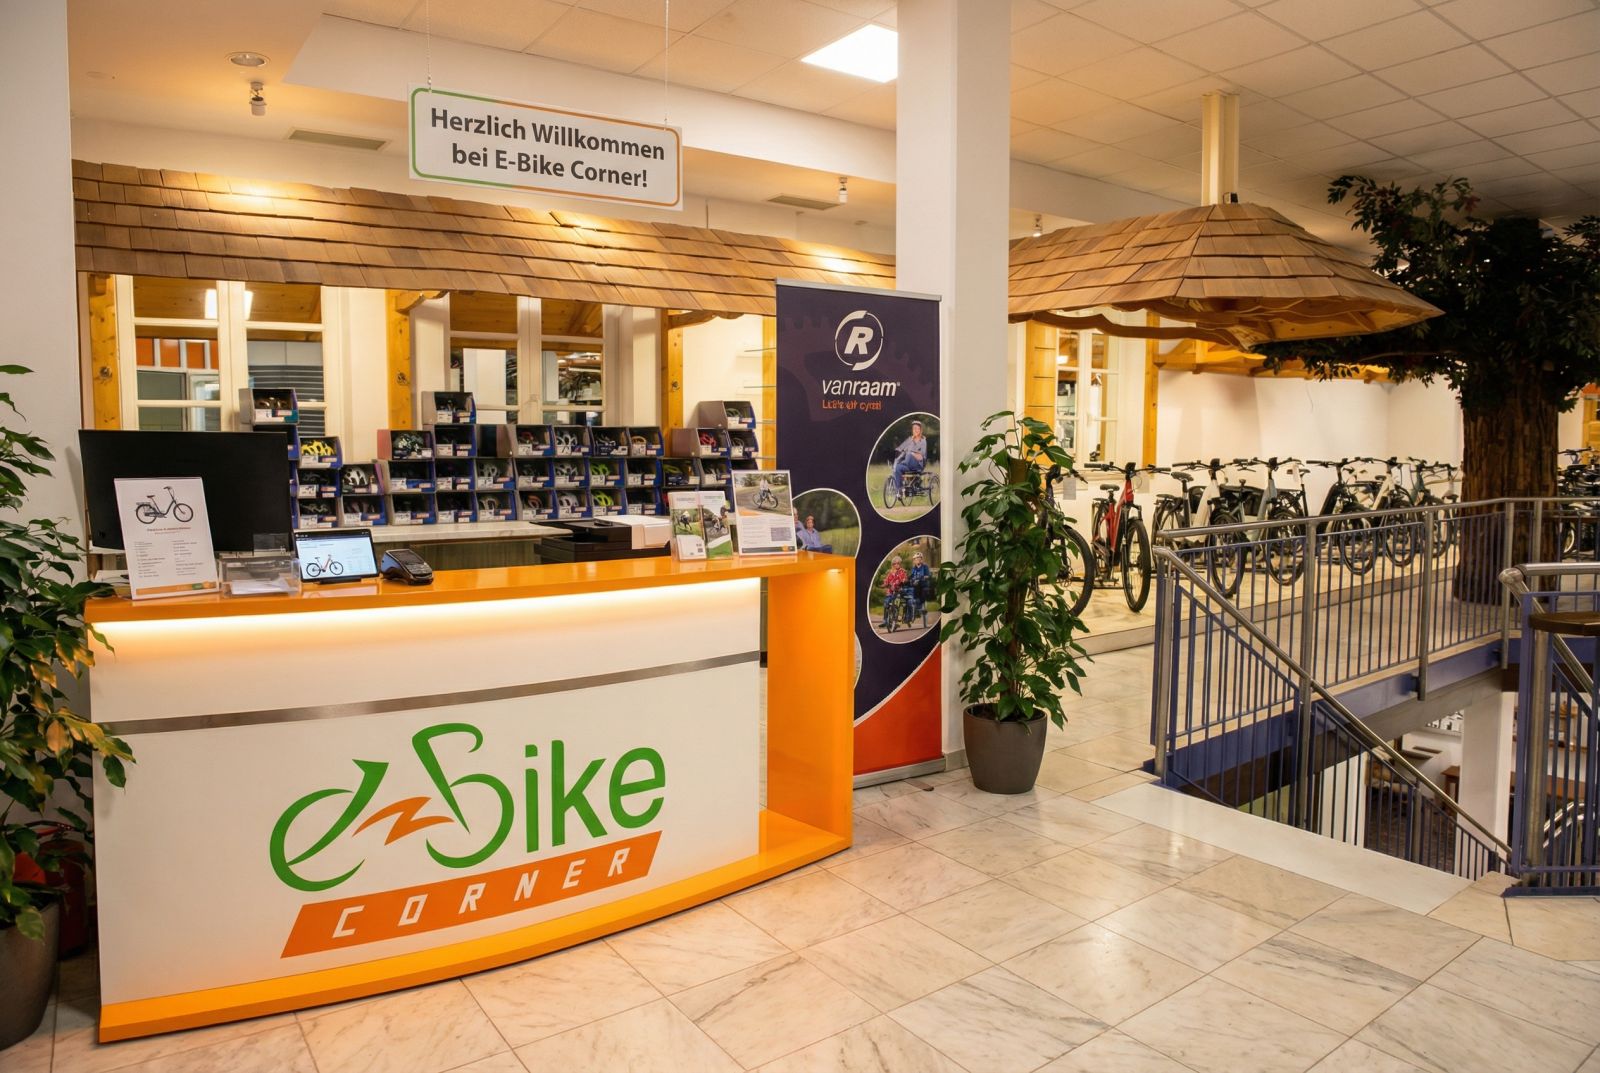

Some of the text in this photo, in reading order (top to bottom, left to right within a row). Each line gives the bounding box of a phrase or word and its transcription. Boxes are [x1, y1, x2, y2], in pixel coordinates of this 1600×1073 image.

[431, 107, 665, 160] Herzlich Willkommen
[452, 143, 648, 187] bei E-Bike Corner!
[844, 326, 874, 355] R
[822, 379, 897, 397] vanraam
[331, 847, 631, 939] CORNER
